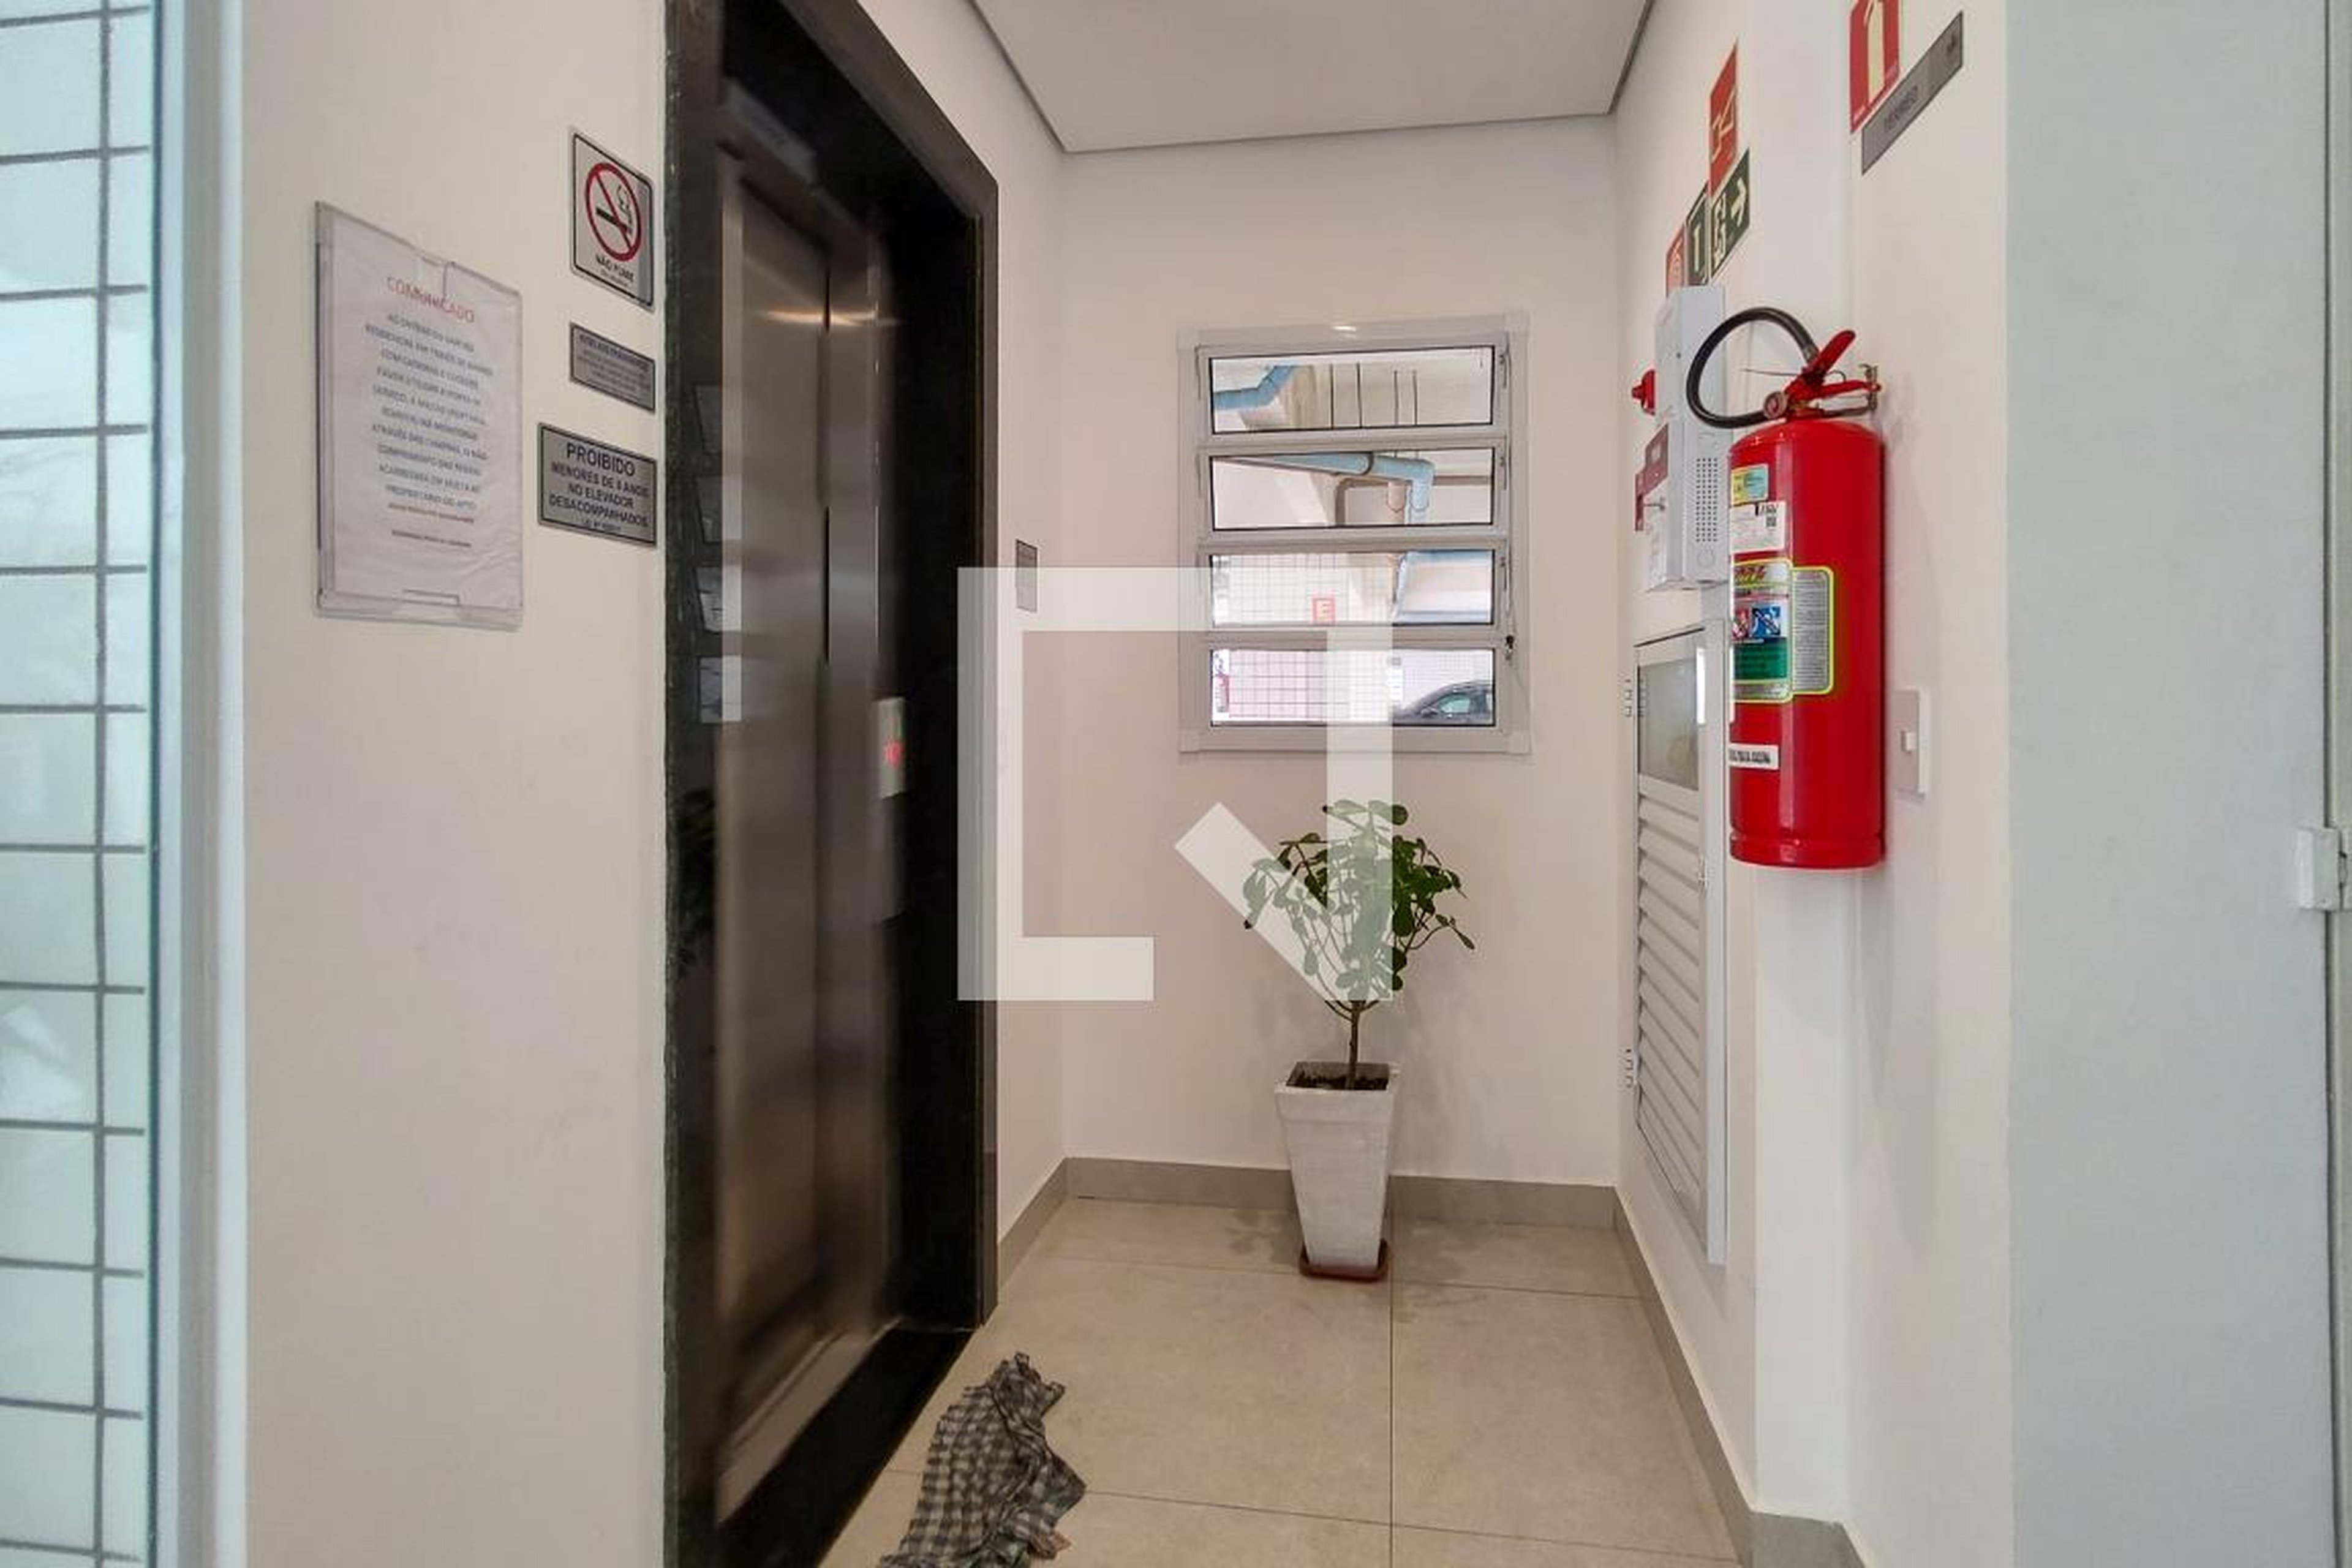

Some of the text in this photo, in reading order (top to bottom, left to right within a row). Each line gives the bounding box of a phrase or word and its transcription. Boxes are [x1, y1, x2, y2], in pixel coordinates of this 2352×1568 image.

[386, 274, 474, 324] COMUNICADO
[552, 459, 598, 485] MENORES
[601, 474, 614, 488] DE
[567, 441, 635, 478] PROIBIDO
[548, 491, 648, 527] DESACOMPANHADOS
[568, 481, 633, 509] NO ELEVADOR
